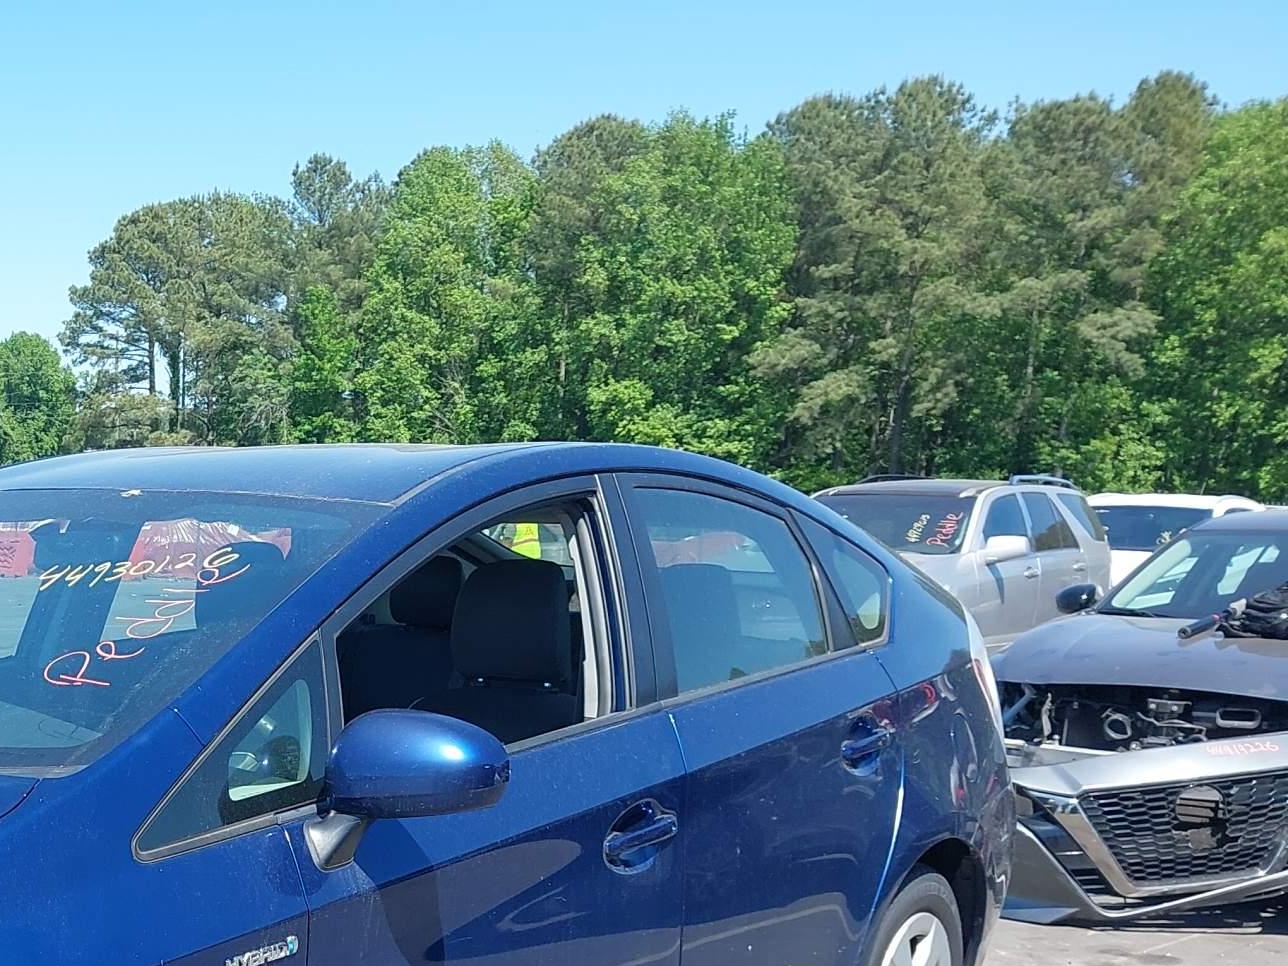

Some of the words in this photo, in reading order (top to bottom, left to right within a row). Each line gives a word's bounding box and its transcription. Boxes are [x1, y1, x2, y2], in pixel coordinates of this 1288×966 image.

[926, 512, 964, 548] Peddle
[39, 547, 240, 591] 44930126
[43, 563, 251, 686] Peddle
